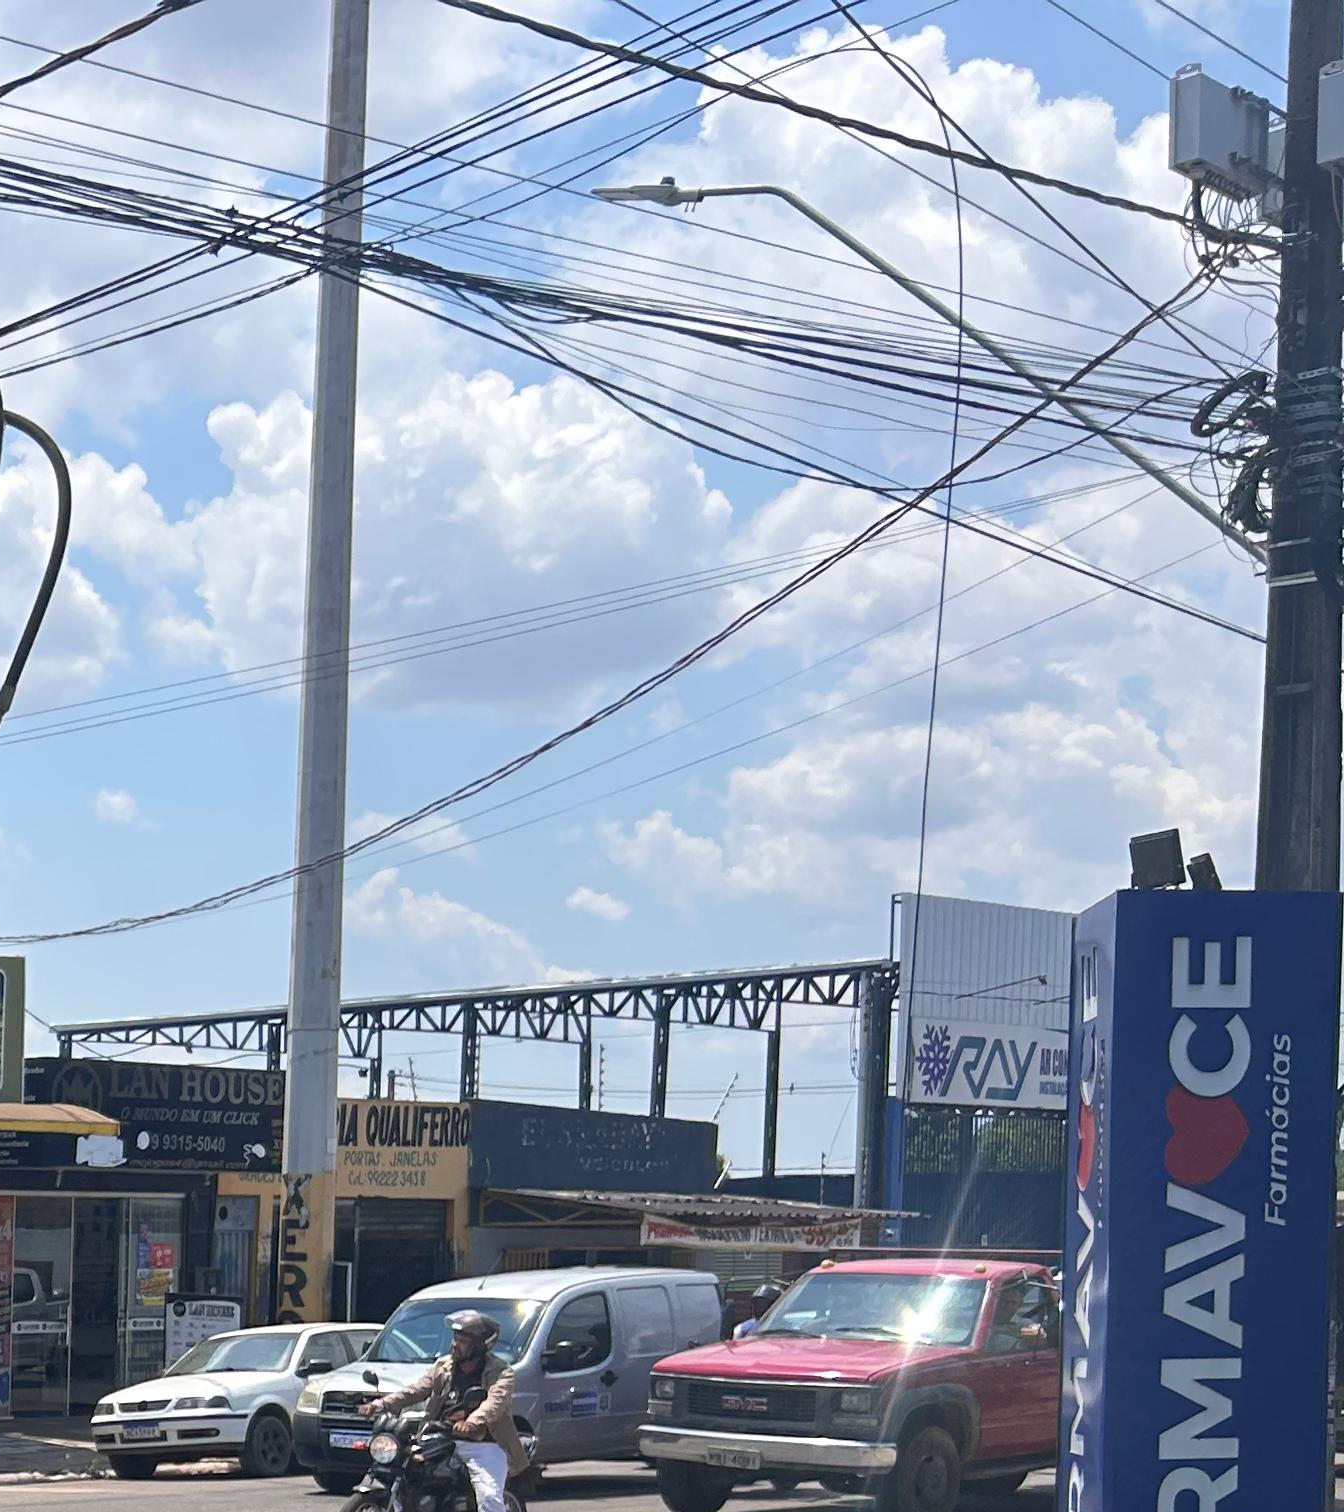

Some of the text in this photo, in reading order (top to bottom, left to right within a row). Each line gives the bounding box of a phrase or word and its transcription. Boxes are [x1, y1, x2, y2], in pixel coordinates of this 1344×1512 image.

[939, 1035, 1038, 1101] RAY
[109, 1064, 284, 1106] LAN HOUSE
[120, 1107, 260, 1126] O MUNDO EM UM CLICK
[336, 1104, 358, 1148] IA
[365, 1105, 469, 1148] QUALIFERRO
[1264, 1032, 1293, 1227] Farmácias
[162, 1135, 226, 1152] 9315-5040
[344, 1151, 437, 1167] PORTAS JANELAS
[721, 1395, 769, 1412] GMC
